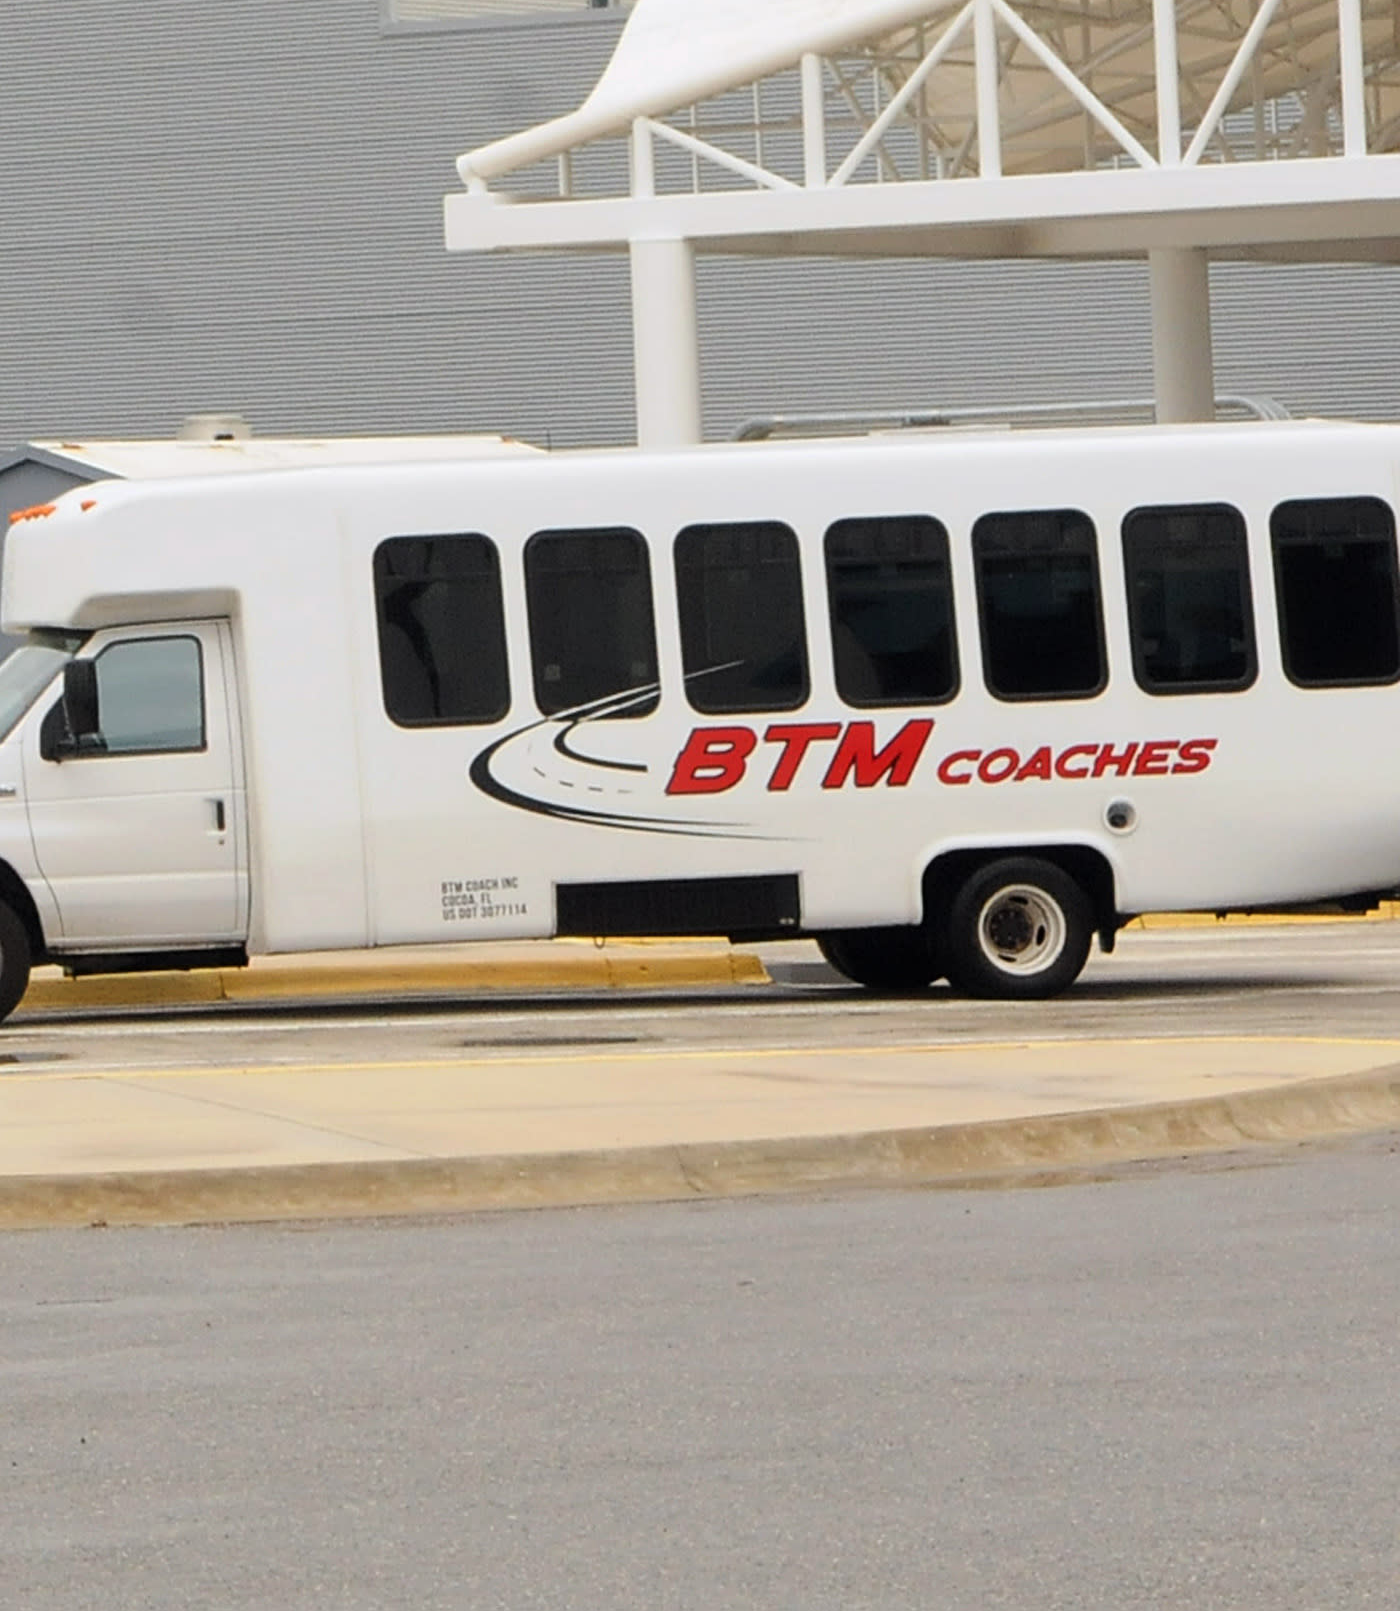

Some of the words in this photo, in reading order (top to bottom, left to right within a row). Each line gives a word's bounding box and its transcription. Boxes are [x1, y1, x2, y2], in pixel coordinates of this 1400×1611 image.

[665, 719, 935, 795] BTM
[937, 738, 1218, 785] COACHES
[441, 881, 462, 894] BTM
[465, 878, 499, 892] COACH
[501, 876, 519, 889] INC
[481, 892, 492, 904] FL
[443, 909, 456, 921] US
[459, 907, 477, 919] DOT
